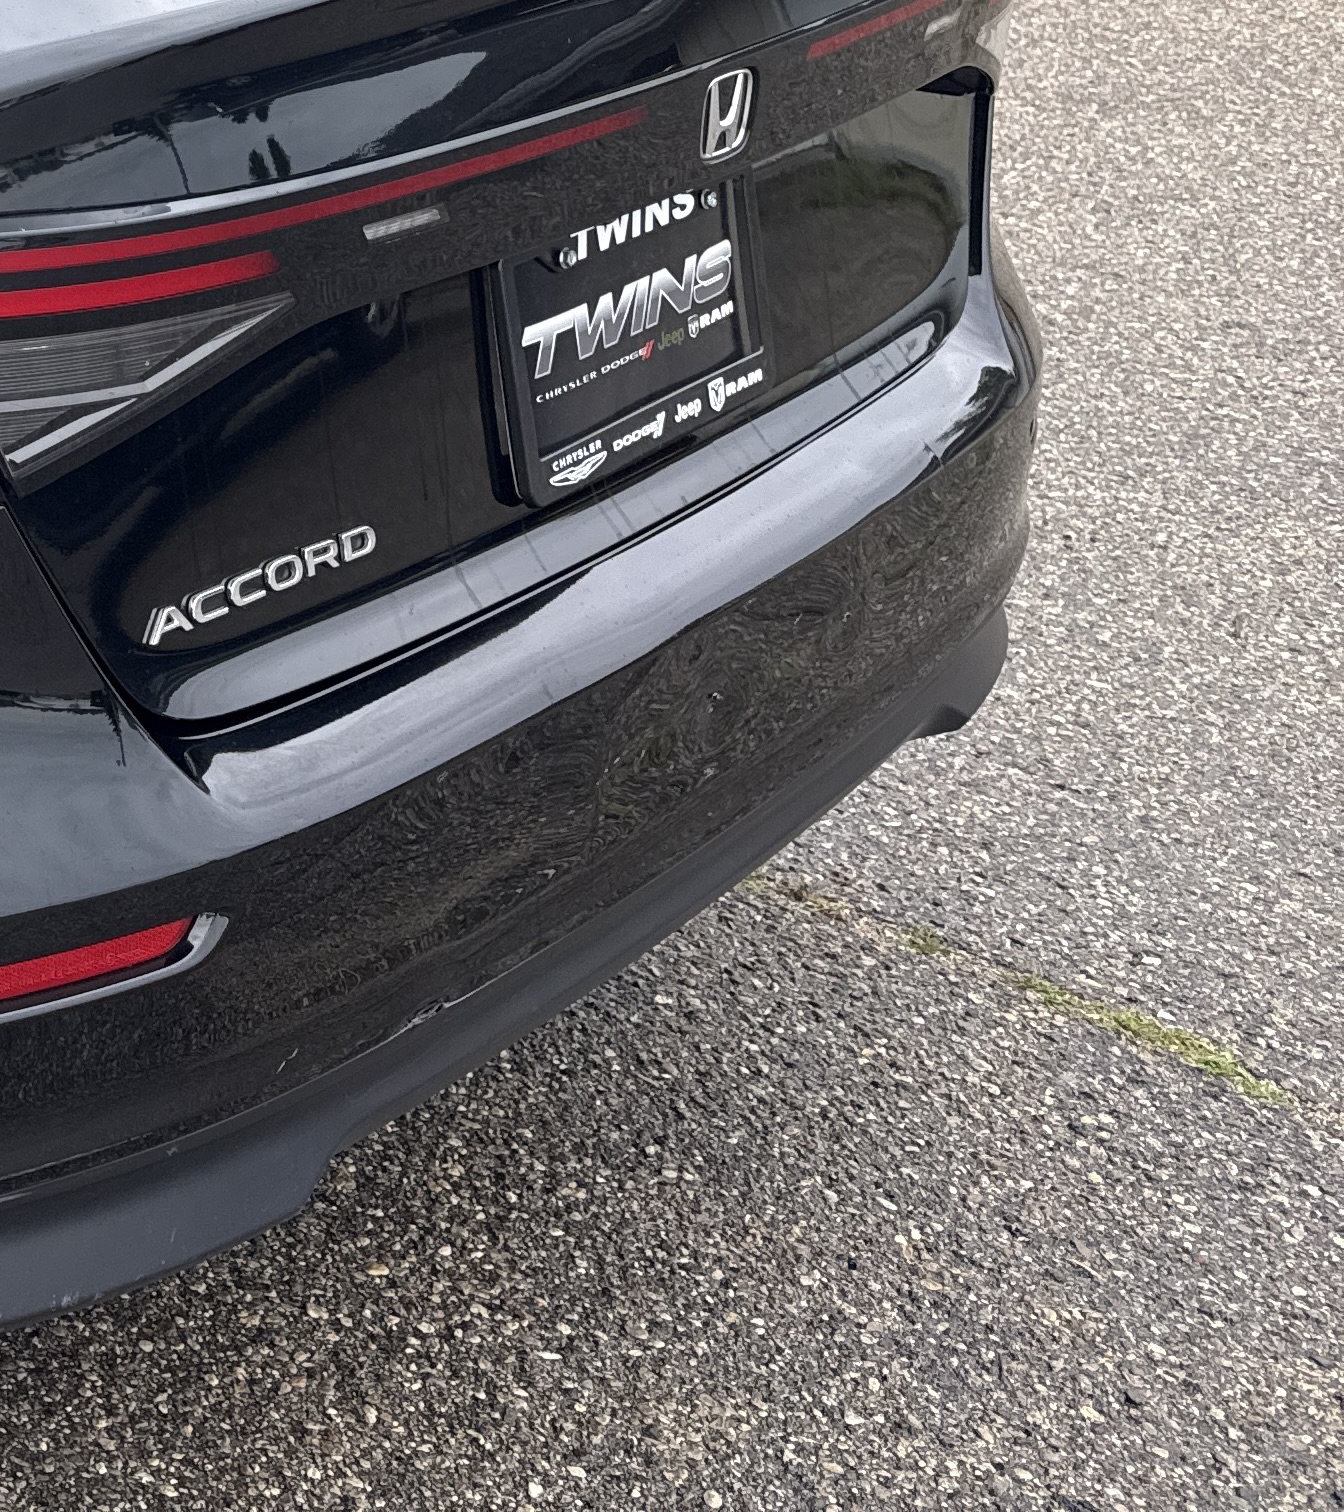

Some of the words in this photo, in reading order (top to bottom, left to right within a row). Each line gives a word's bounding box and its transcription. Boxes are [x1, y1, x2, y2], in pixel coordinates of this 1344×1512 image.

[569, 188, 695, 262] TWINS
[521, 239, 733, 380] TWINS
[535, 370, 598, 403] CHRYSLER
[601, 347, 647, 377] DODGE
[657, 326, 685, 351] Jeep
[699, 300, 735, 329] RAM
[552, 439, 602, 472] CHRYSLER
[613, 418, 660, 452] DODGE
[674, 397, 702, 423] Jeep
[725, 368, 764, 398] RAM
[144, 525, 377, 646] ACCORD
